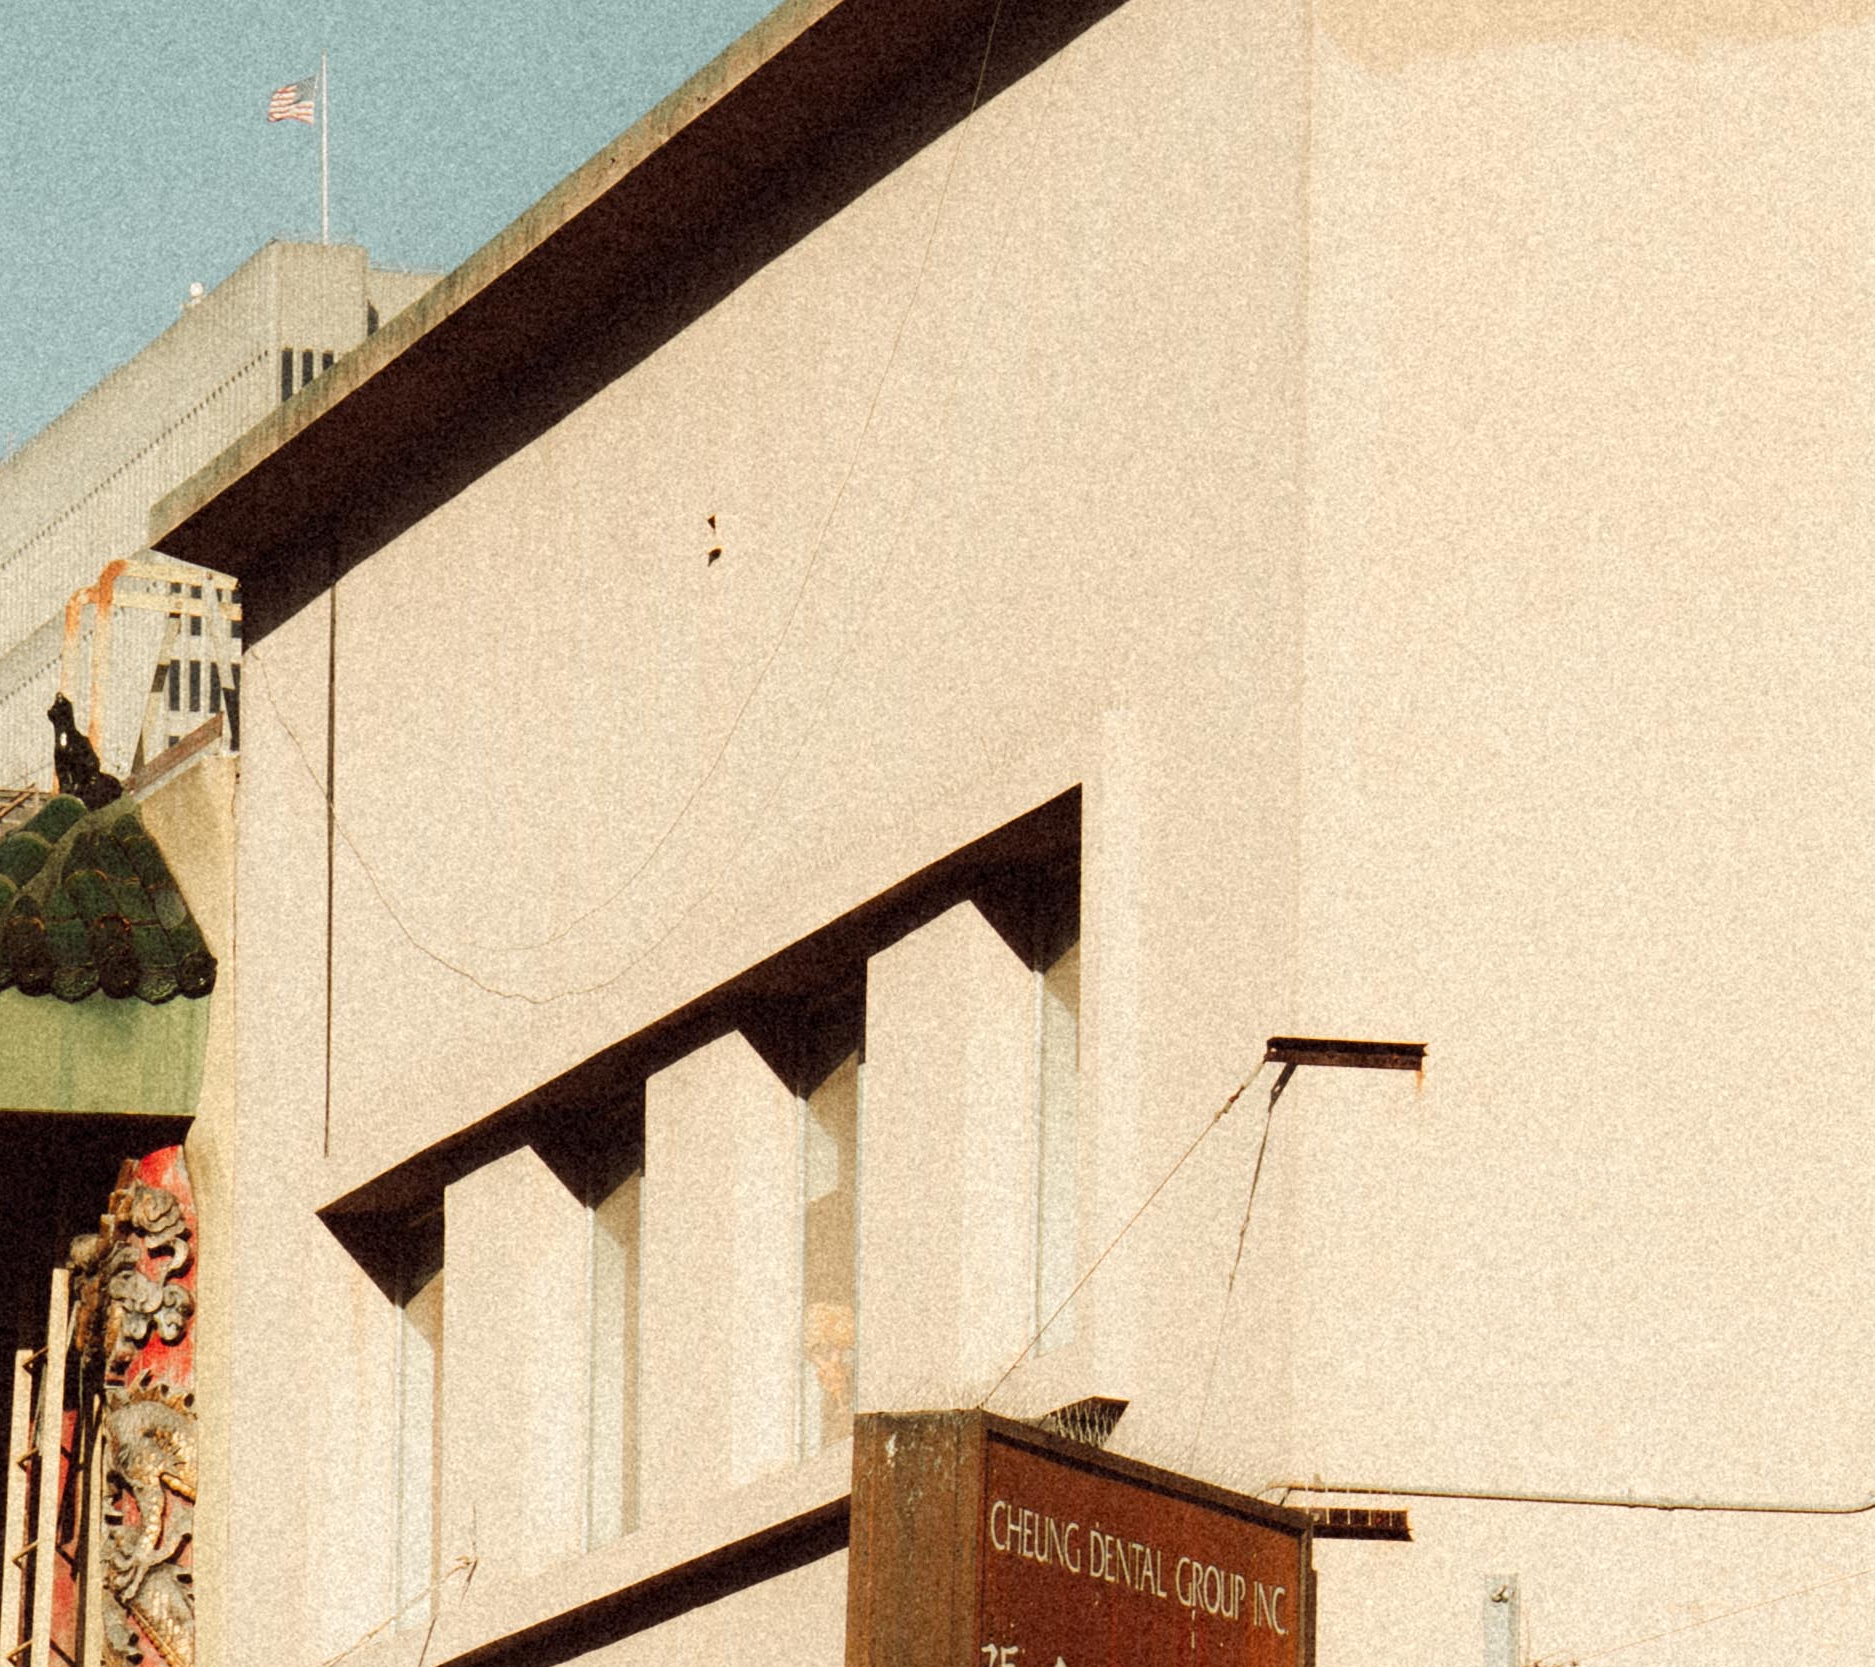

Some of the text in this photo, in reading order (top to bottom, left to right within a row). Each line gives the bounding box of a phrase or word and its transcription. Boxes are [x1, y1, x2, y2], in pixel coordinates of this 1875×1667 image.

[990, 1499, 1080, 1574] CHEUNG
[1089, 1527, 1168, 1599] DENTAL
[1176, 1557, 1245, 1620] GROUP
